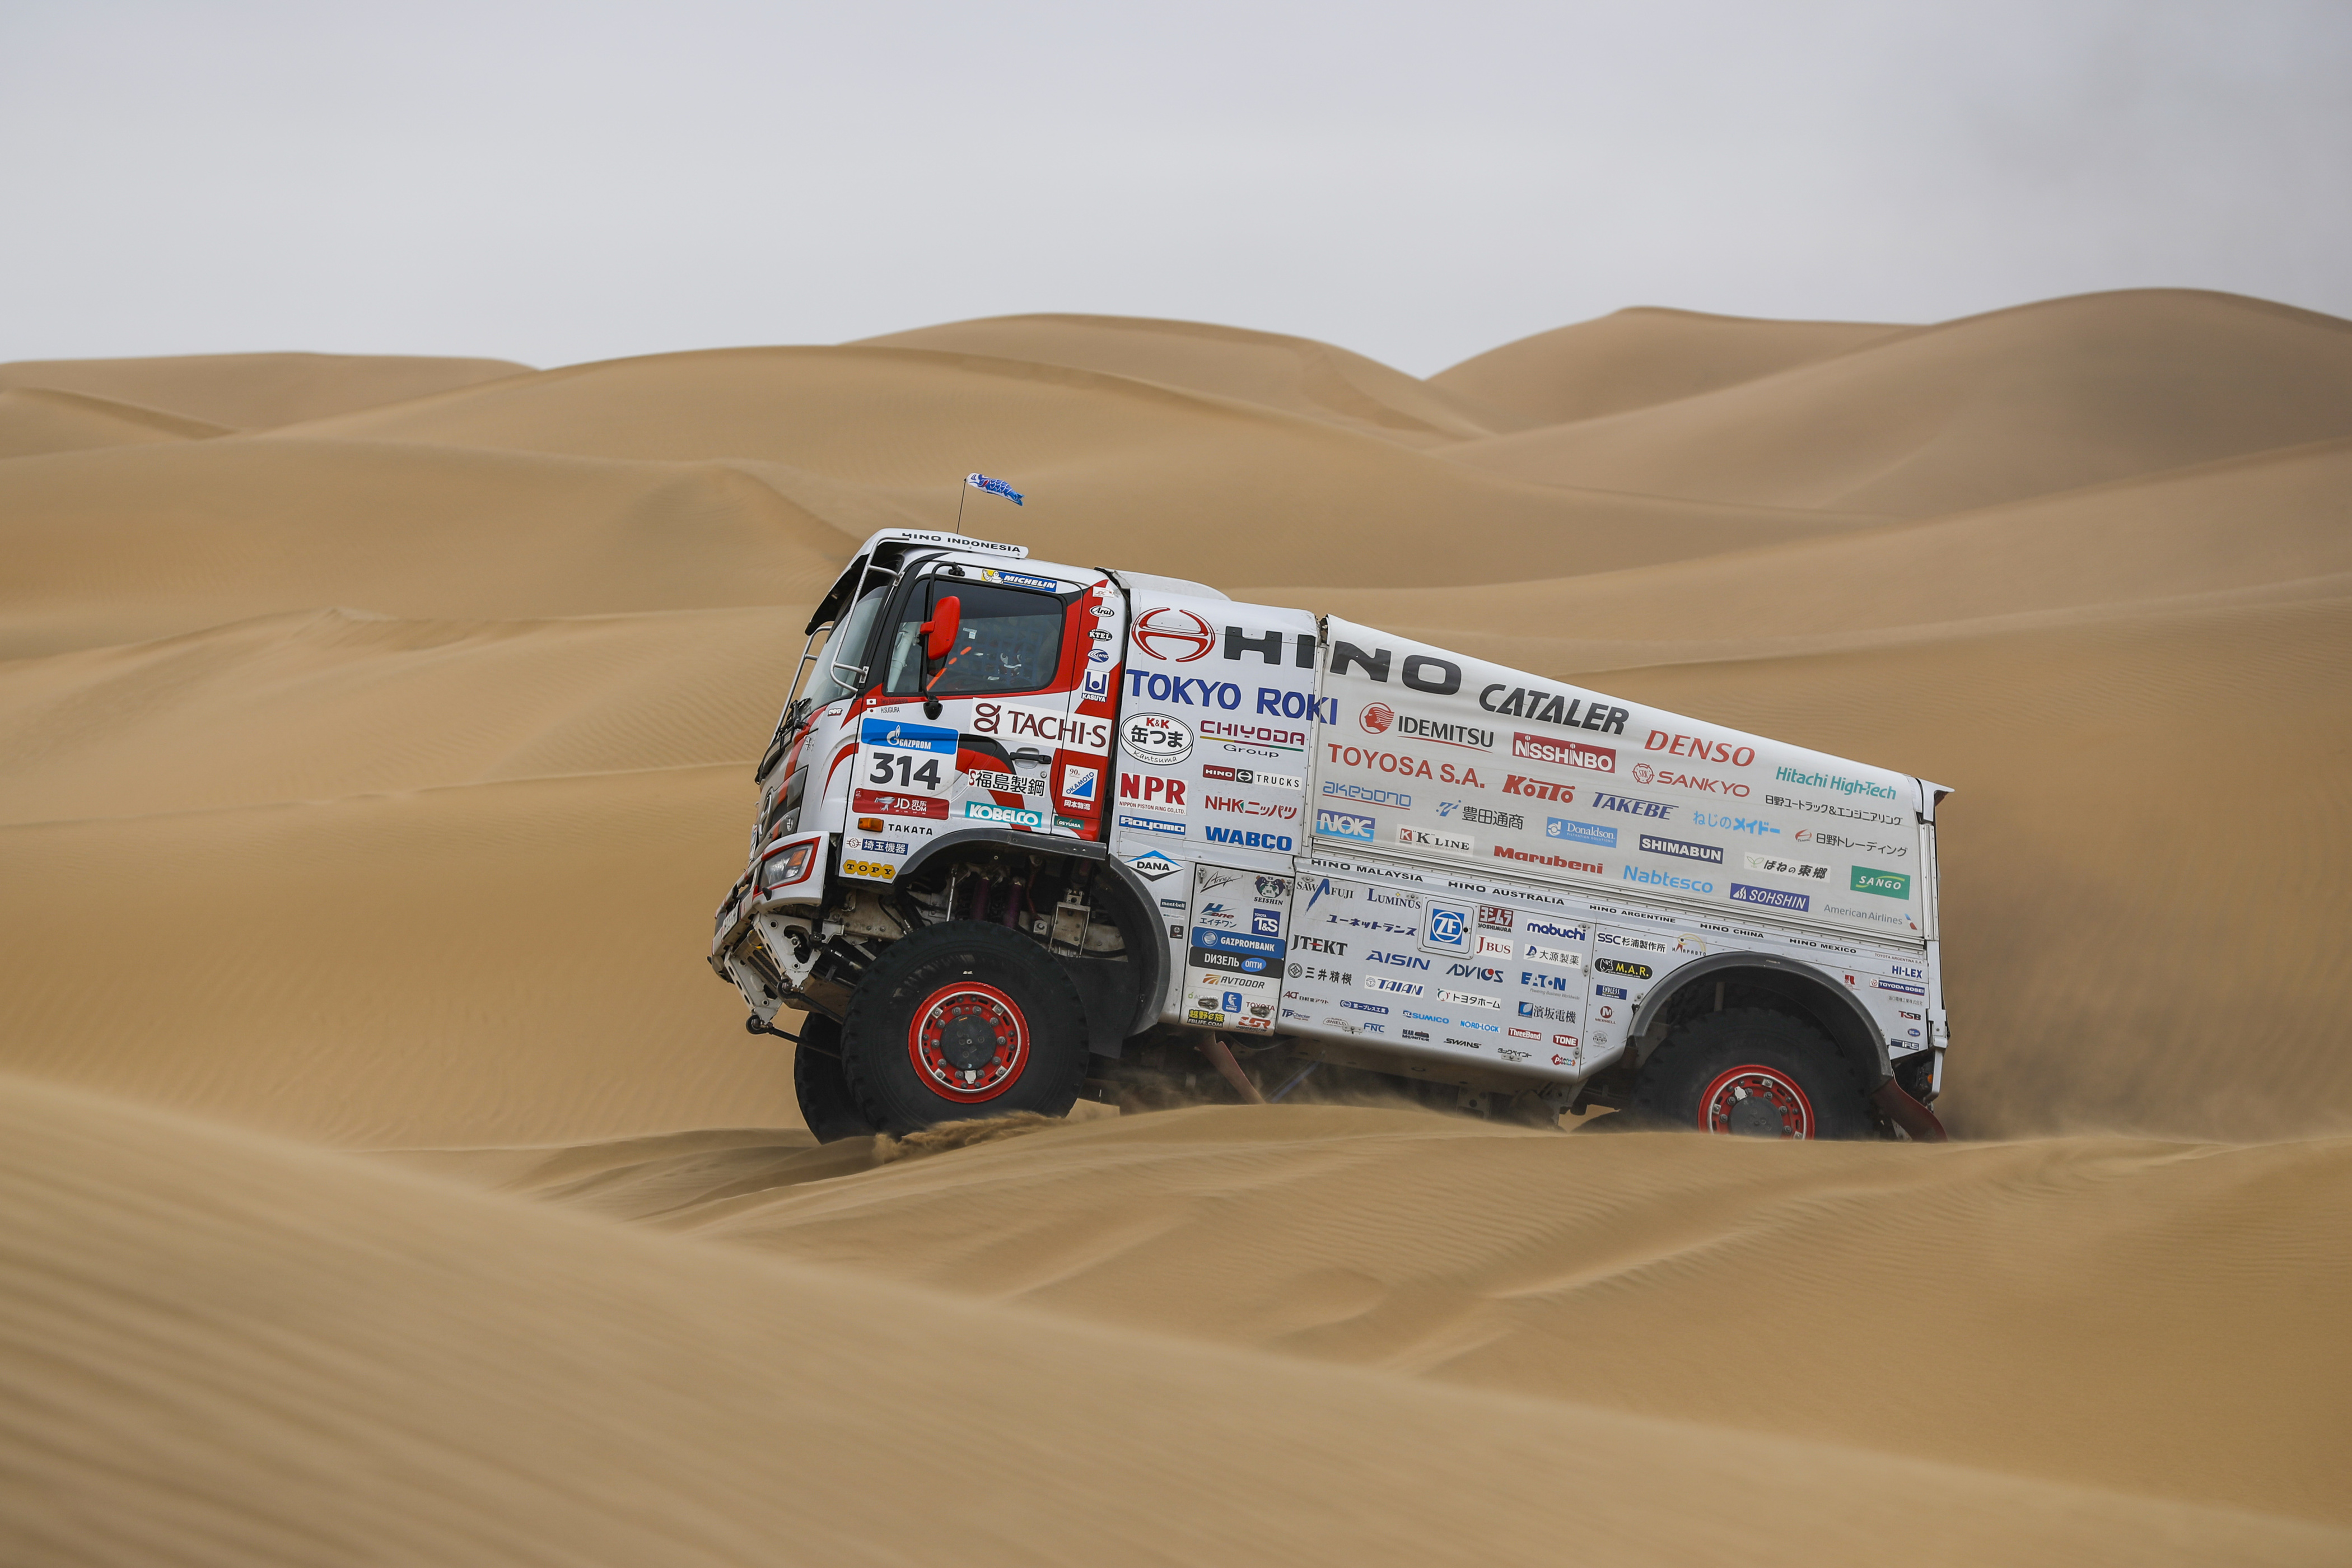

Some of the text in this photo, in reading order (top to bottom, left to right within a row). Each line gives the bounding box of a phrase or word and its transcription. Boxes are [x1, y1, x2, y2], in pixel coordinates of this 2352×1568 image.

[948, 538, 1021, 552] INDONESIA
[1003, 575, 1056, 589] MICHELIN
[1224, 626, 1462, 695] HINO
[1082, 694, 1106, 702] KASUYA
[1126, 669, 1338, 726] TOKYO ROKI
[1478, 683, 1630, 735] CATALER
[1007, 710, 1107, 748] TACHI-S
[1146, 717, 1170, 729] K&K
[1398, 715, 1495, 748] IDEMITSU
[1131, 725, 1183, 749] 缶つま
[1200, 720, 1306, 746] CHIYODA
[899, 739, 932, 750] GAZPROM
[1224, 744, 1280, 759] Group
[1644, 730, 1756, 767] DENSO
[1133, 750, 1178, 763] Kantsuma
[1328, 743, 1485, 788] TOYOSA S.A.
[870, 752, 941, 790] 314
[1205, 769, 1233, 778] HINO
[976, 771, 1046, 796] 福島製鋼
[1066, 772, 1094, 795] OKAMOTO
[1121, 773, 1186, 805] NPR
[1256, 774, 1300, 788] TRUCKS
[1656, 771, 1750, 797] SANKYO
[1775, 766, 1897, 800] Hitachi High-Tech
[1322, 781, 1411, 807] akebono
[969, 804, 1038, 825] KOBELCO
[1064, 800, 1091, 810] 岡本物流
[1592, 792, 1679, 820] TAKEBE
[1319, 813, 1371, 837] NOK
[1462, 806, 1524, 830] 豊田通商
[1693, 811, 1780, 836] ねじのメイドー
[888, 824, 933, 836] TAKATA
[1205, 825, 1292, 851] WABCO
[864, 840, 906, 854] 埼玉機器
[1435, 837, 1470, 851] LINE
[1641, 838, 1721, 861] SHIMABUN
[1817, 833, 1908, 857] 日野トレーディング
[847, 864, 893, 875] TOPY
[1137, 861, 1170, 871] DANA
[1494, 846, 1603, 874] Marubeni
[1764, 860, 1828, 879] ばねの東郷
[1312, 860, 1423, 882] HINO MALAYSIA
[1623, 865, 1714, 893] Nabtesco
[1859, 875, 1901, 890] SANGO
[1254, 897, 1284, 906] SEISHIN
[1448, 881, 1565, 905] HINO AUSTRALIA
[1749, 889, 1807, 910] SOHSHIN
[1200, 917, 1237, 928] エイチワン
[1480, 906, 1513, 927] ヨシムラ
[1590, 905, 1676, 923] HINO ARGENTINE
[1823, 904, 1903, 925] American Airlines
[1254, 917, 1278, 932] T&S
[1326, 914, 1417, 936] ユーネットランス
[1435, 916, 1460, 937] ZF
[1478, 923, 1512, 933] YOSHIMURA
[1527, 922, 1586, 941] mabuchi
[1700, 923, 1764, 939] HINO CHINA
[1220, 936, 1275, 951] GAZPROMBANK
[1291, 935, 1348, 956] JTEKT
[1790, 938, 1857, 953] HINO MEXICO
[1365, 950, 1431, 970] AISIN
[1539, 950, 1579, 965] 大源製薬
[1305, 967, 1352, 986] 三井精機
[1446, 963, 1504, 983] ADVICS
[1616, 963, 1649, 977] M.A.R.
[1892, 965, 1922, 979] HI-LEX
[1220, 976, 1265, 989] AVTODOR
[1378, 978, 1423, 995] TAIAN
[1521, 972, 1566, 991] EATON
[1602, 986, 1620, 995] ENDLESS
[1879, 982, 1904, 990] TOYODA
[1453, 993, 1500, 1009] トヨタホーム
[1188, 1019, 1222, 1028] FBLIFE.COM
[1412, 1012, 1450, 1024] SUMICO
[1460, 1020, 1499, 1032] NORD-LOCK
[1444, 1038, 1481, 1049] SWANS
[1509, 1028, 1541, 1040] ThreeBond
[1555, 1035, 1577, 1047] TONE
